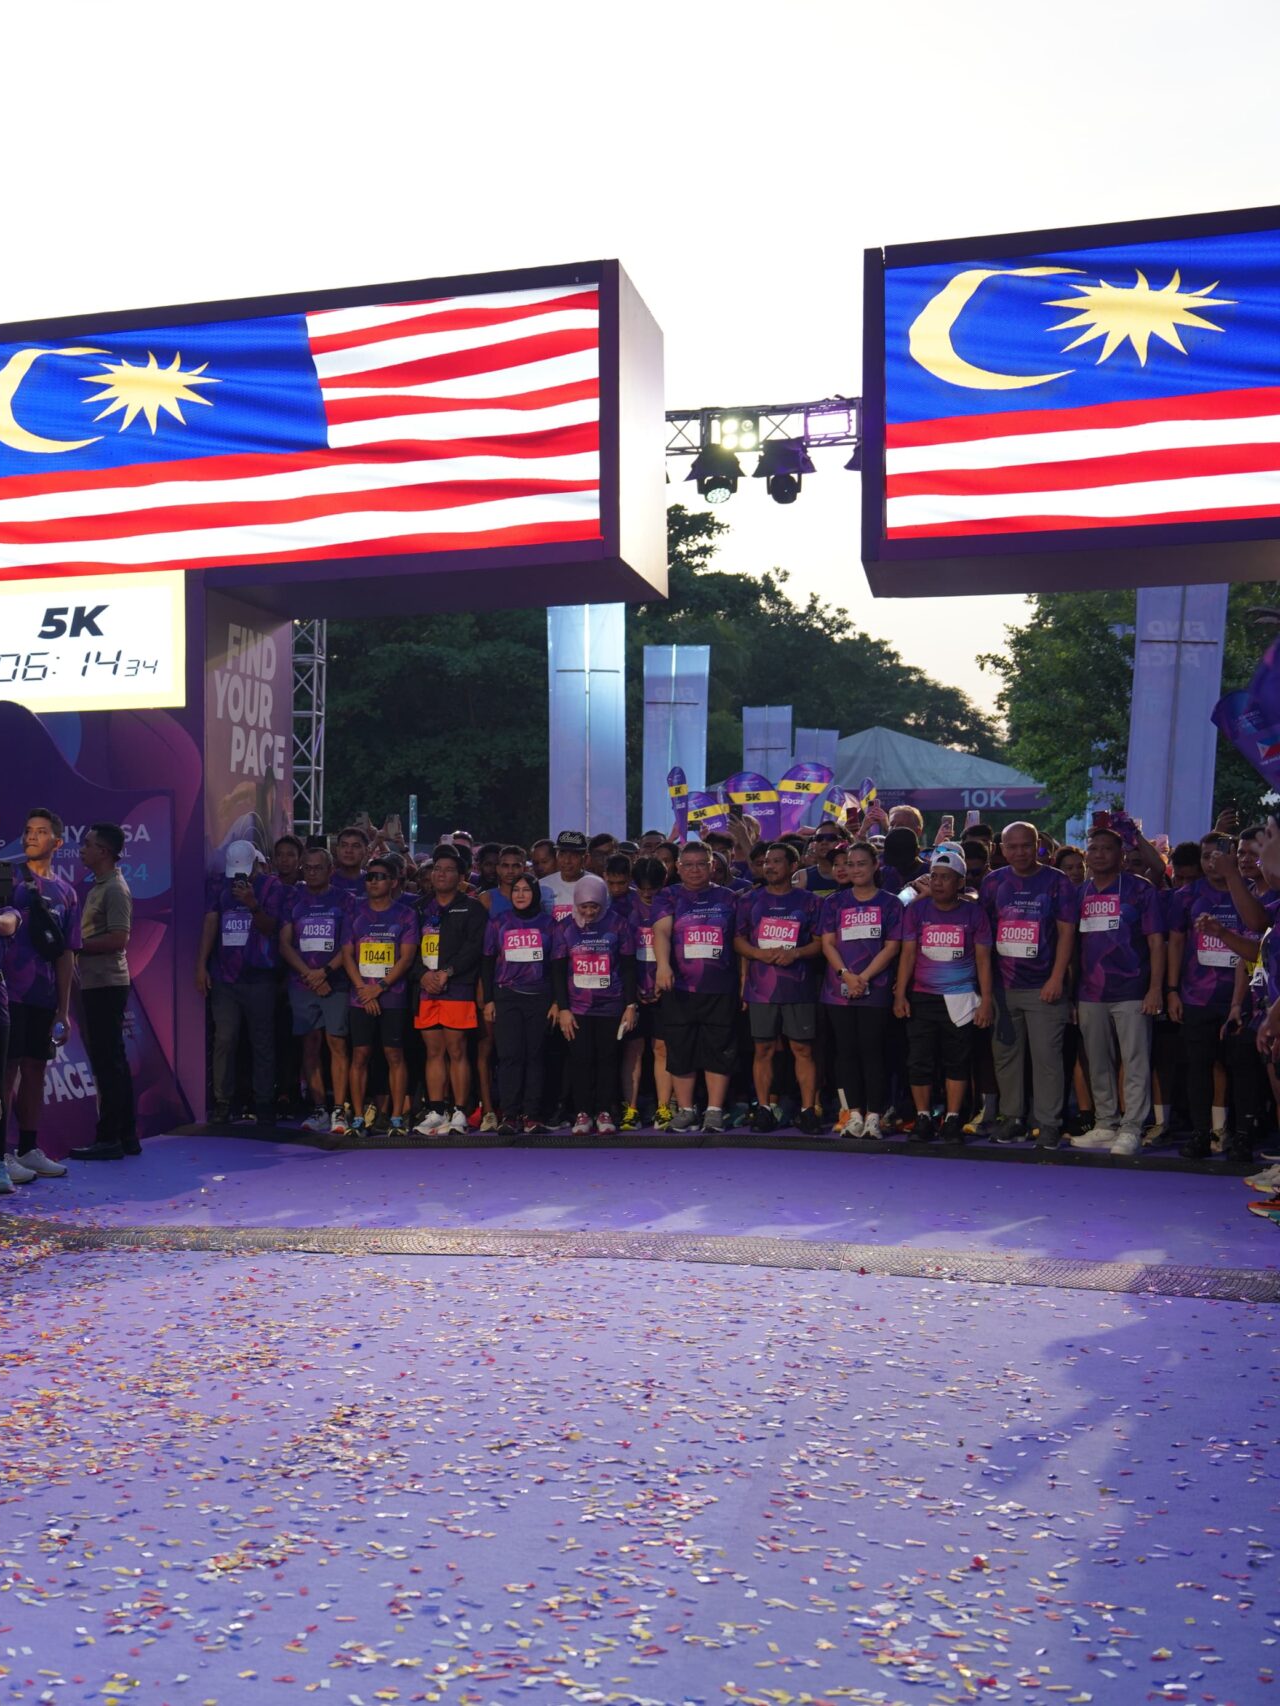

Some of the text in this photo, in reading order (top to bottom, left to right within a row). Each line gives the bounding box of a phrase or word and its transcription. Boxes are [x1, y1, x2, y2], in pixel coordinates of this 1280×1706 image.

[37, 604, 109, 639] 5K
[226, 623, 277, 681] FIND
[214, 669, 273, 730] YOUR
[230, 726, 286, 780] PACE
[794, 782, 811, 791] 5K
[744, 792, 761, 801] 5K
[960, 790, 1007, 808] 10K
[692, 809, 708, 819] 5K
[1084, 901, 1116, 915] 30080
[845, 911, 877, 925] 25088
[302, 924, 332, 937] 40352
[687, 931, 719, 943] 30102
[762, 924, 794, 939] 30064
[1001, 926, 1035, 941] 30095
[507, 934, 538, 947] 25112
[926, 931, 961, 945] 30085
[363, 950, 391, 962] 10441
[576, 960, 607, 973] 25114
